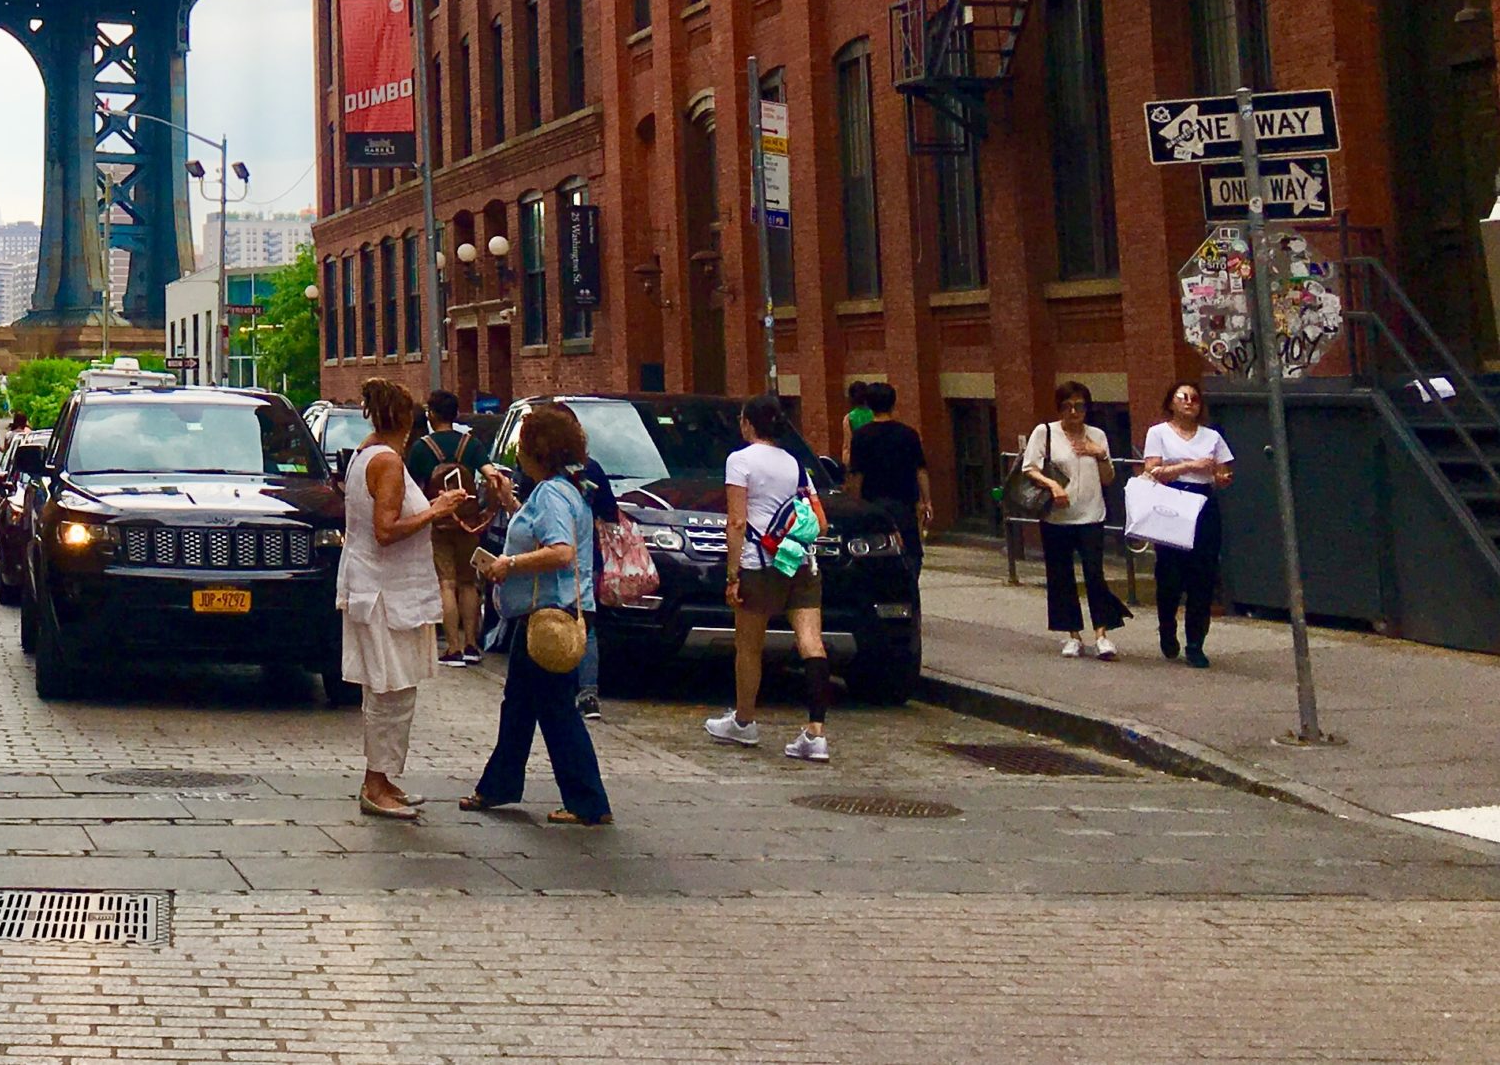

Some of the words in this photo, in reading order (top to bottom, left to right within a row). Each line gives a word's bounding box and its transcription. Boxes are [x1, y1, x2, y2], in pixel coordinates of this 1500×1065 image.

[344, 78, 413, 113] DUMBO
[1178, 116, 1231, 142] ONE
[1255, 110, 1310, 136] WAY
[1269, 177, 1308, 202] WAY
[570, 212, 580, 222] 25
[570, 224, 581, 272] Washington
[688, 517, 727, 525] RAN
